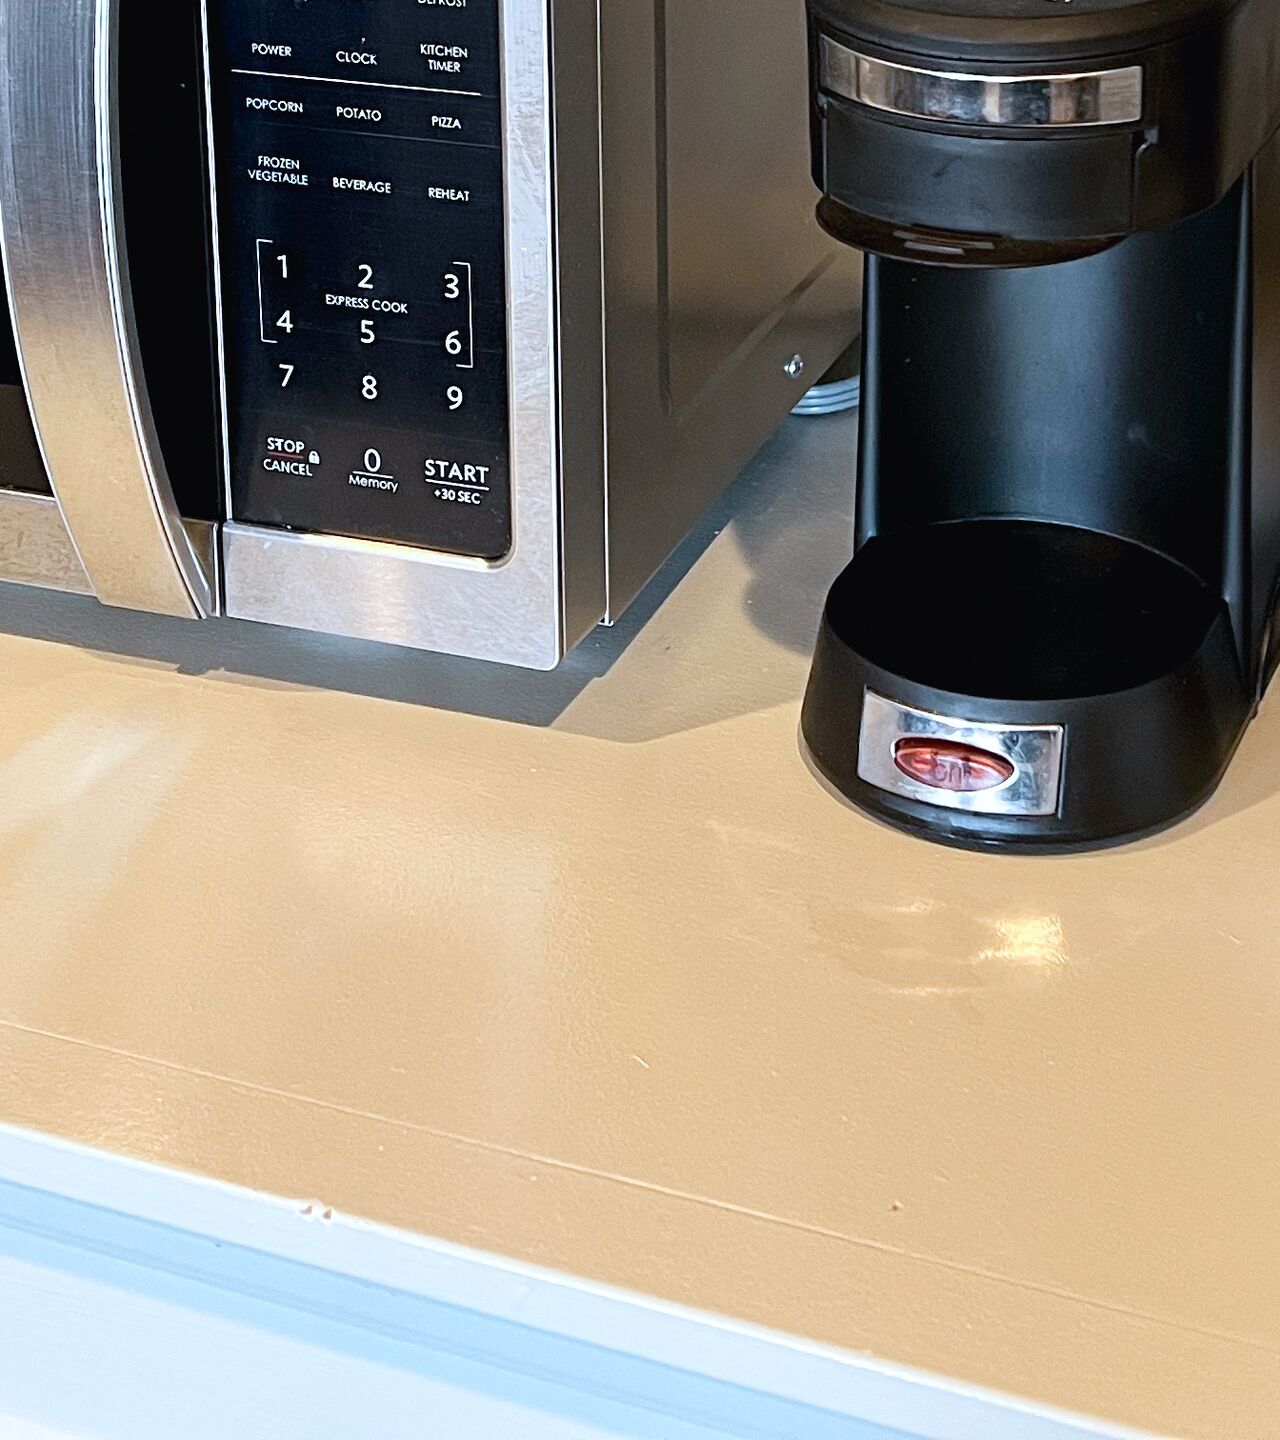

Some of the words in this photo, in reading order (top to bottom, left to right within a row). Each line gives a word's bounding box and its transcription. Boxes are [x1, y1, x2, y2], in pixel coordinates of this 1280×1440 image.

[251, 42, 292, 57] POWER
[335, 51, 378, 66] CLOCK
[420, 43, 468, 59] KITCHEN
[428, 59, 461, 73] TIMER
[246, 97, 303, 113] POPCORN
[336, 106, 382, 122] POTATO
[431, 115, 462, 130] PIZZA
[257, 155, 300, 171] FROZEN
[247, 169, 309, 186] VEGETABLE
[332, 176, 392, 194] BEVERAGE
[428, 187, 470, 202] REHEAT
[276, 254, 288, 278] 1
[357, 264, 374, 290] 2
[443, 273, 460, 299] 3
[325, 293, 369, 310] EXPRESS
[371, 299, 408, 315] COOK
[276, 309, 294, 334] 4
[360, 319, 375, 344] 5
[445, 329, 462, 355] 6
[279, 363, 294, 388] 7
[361, 374, 378, 400] 8
[446, 385, 464, 410] 9
[266, 436, 305, 455] STOP
[263, 458, 313, 477] CANCEL
[363, 447, 382, 473] 0
[424, 458, 490, 484] START
[348, 473, 399, 493] Memory
[434, 488, 456, 502] +30
[457, 489, 481, 505] SEC
